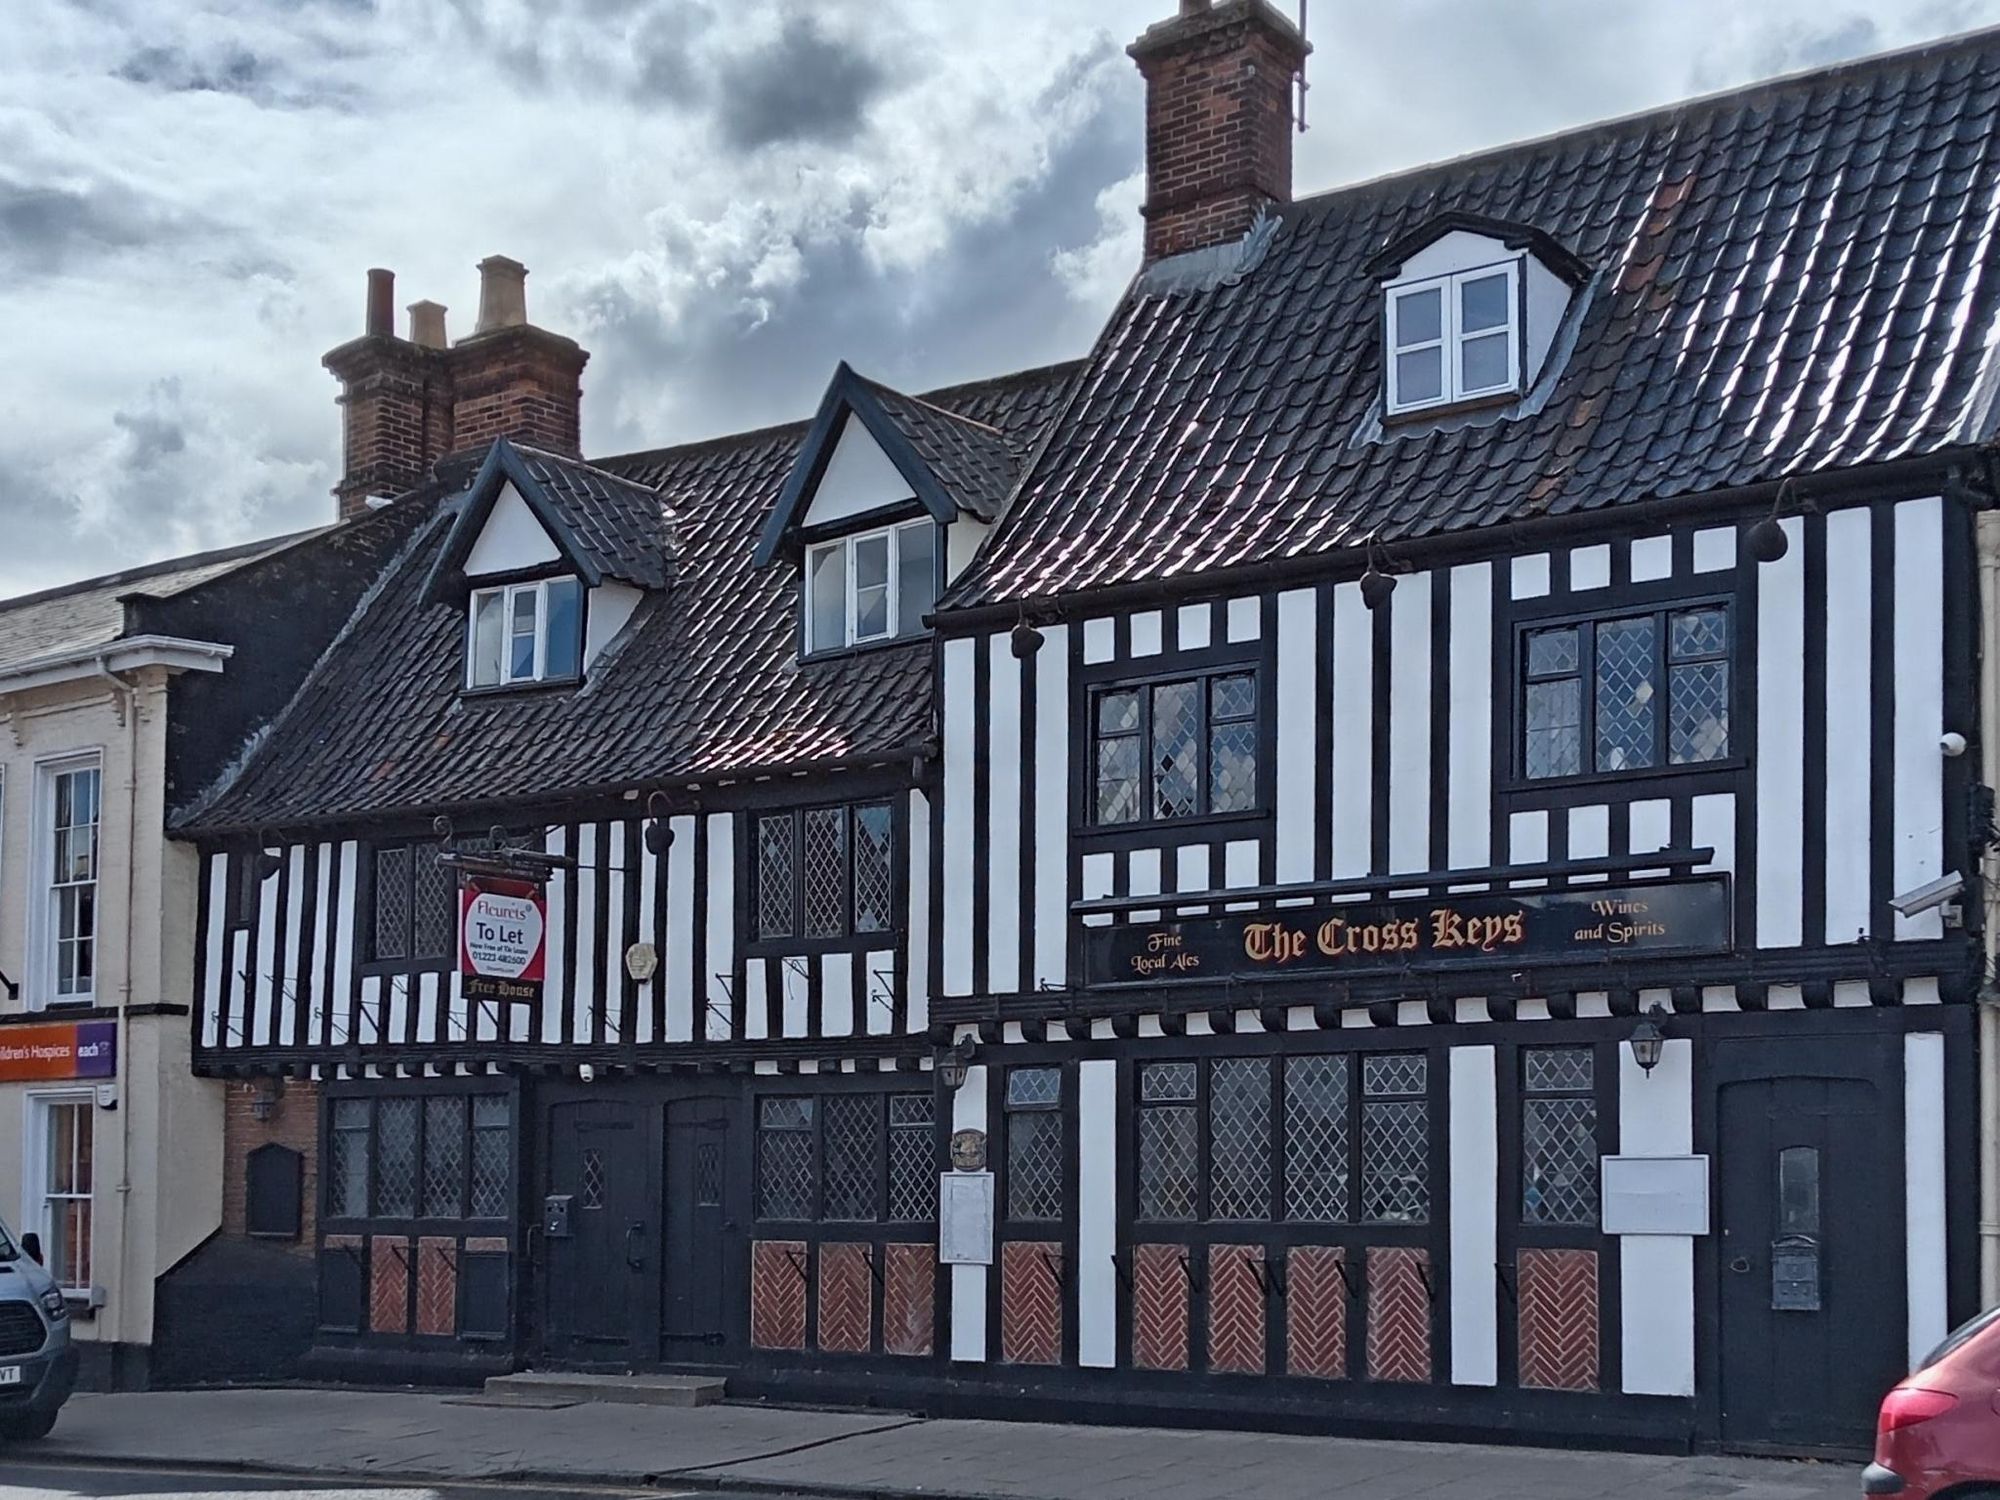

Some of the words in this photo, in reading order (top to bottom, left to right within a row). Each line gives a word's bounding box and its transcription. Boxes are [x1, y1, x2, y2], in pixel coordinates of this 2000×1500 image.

[478, 901, 526, 920] Fleurets
[1591, 898, 1649, 917] Wines
[476, 922, 495, 940] To
[499, 925, 524, 944] Let
[1147, 932, 1182, 952] Fine
[1243, 921, 1308, 964] The
[1316, 916, 1420, 956] Cross
[1429, 907, 1525, 952] Keys
[1574, 923, 1604, 941] and
[1606, 921, 1666, 943] Spirits
[472, 951, 497, 962] 01223
[1130, 953, 1166, 975] Local
[1169, 952, 1200, 971] Ales
[467, 978, 496, 995] Free
[497, 980, 535, 998] House
[31, 1043, 70, 1062] Hospices
[77, 1042, 99, 1057] each
